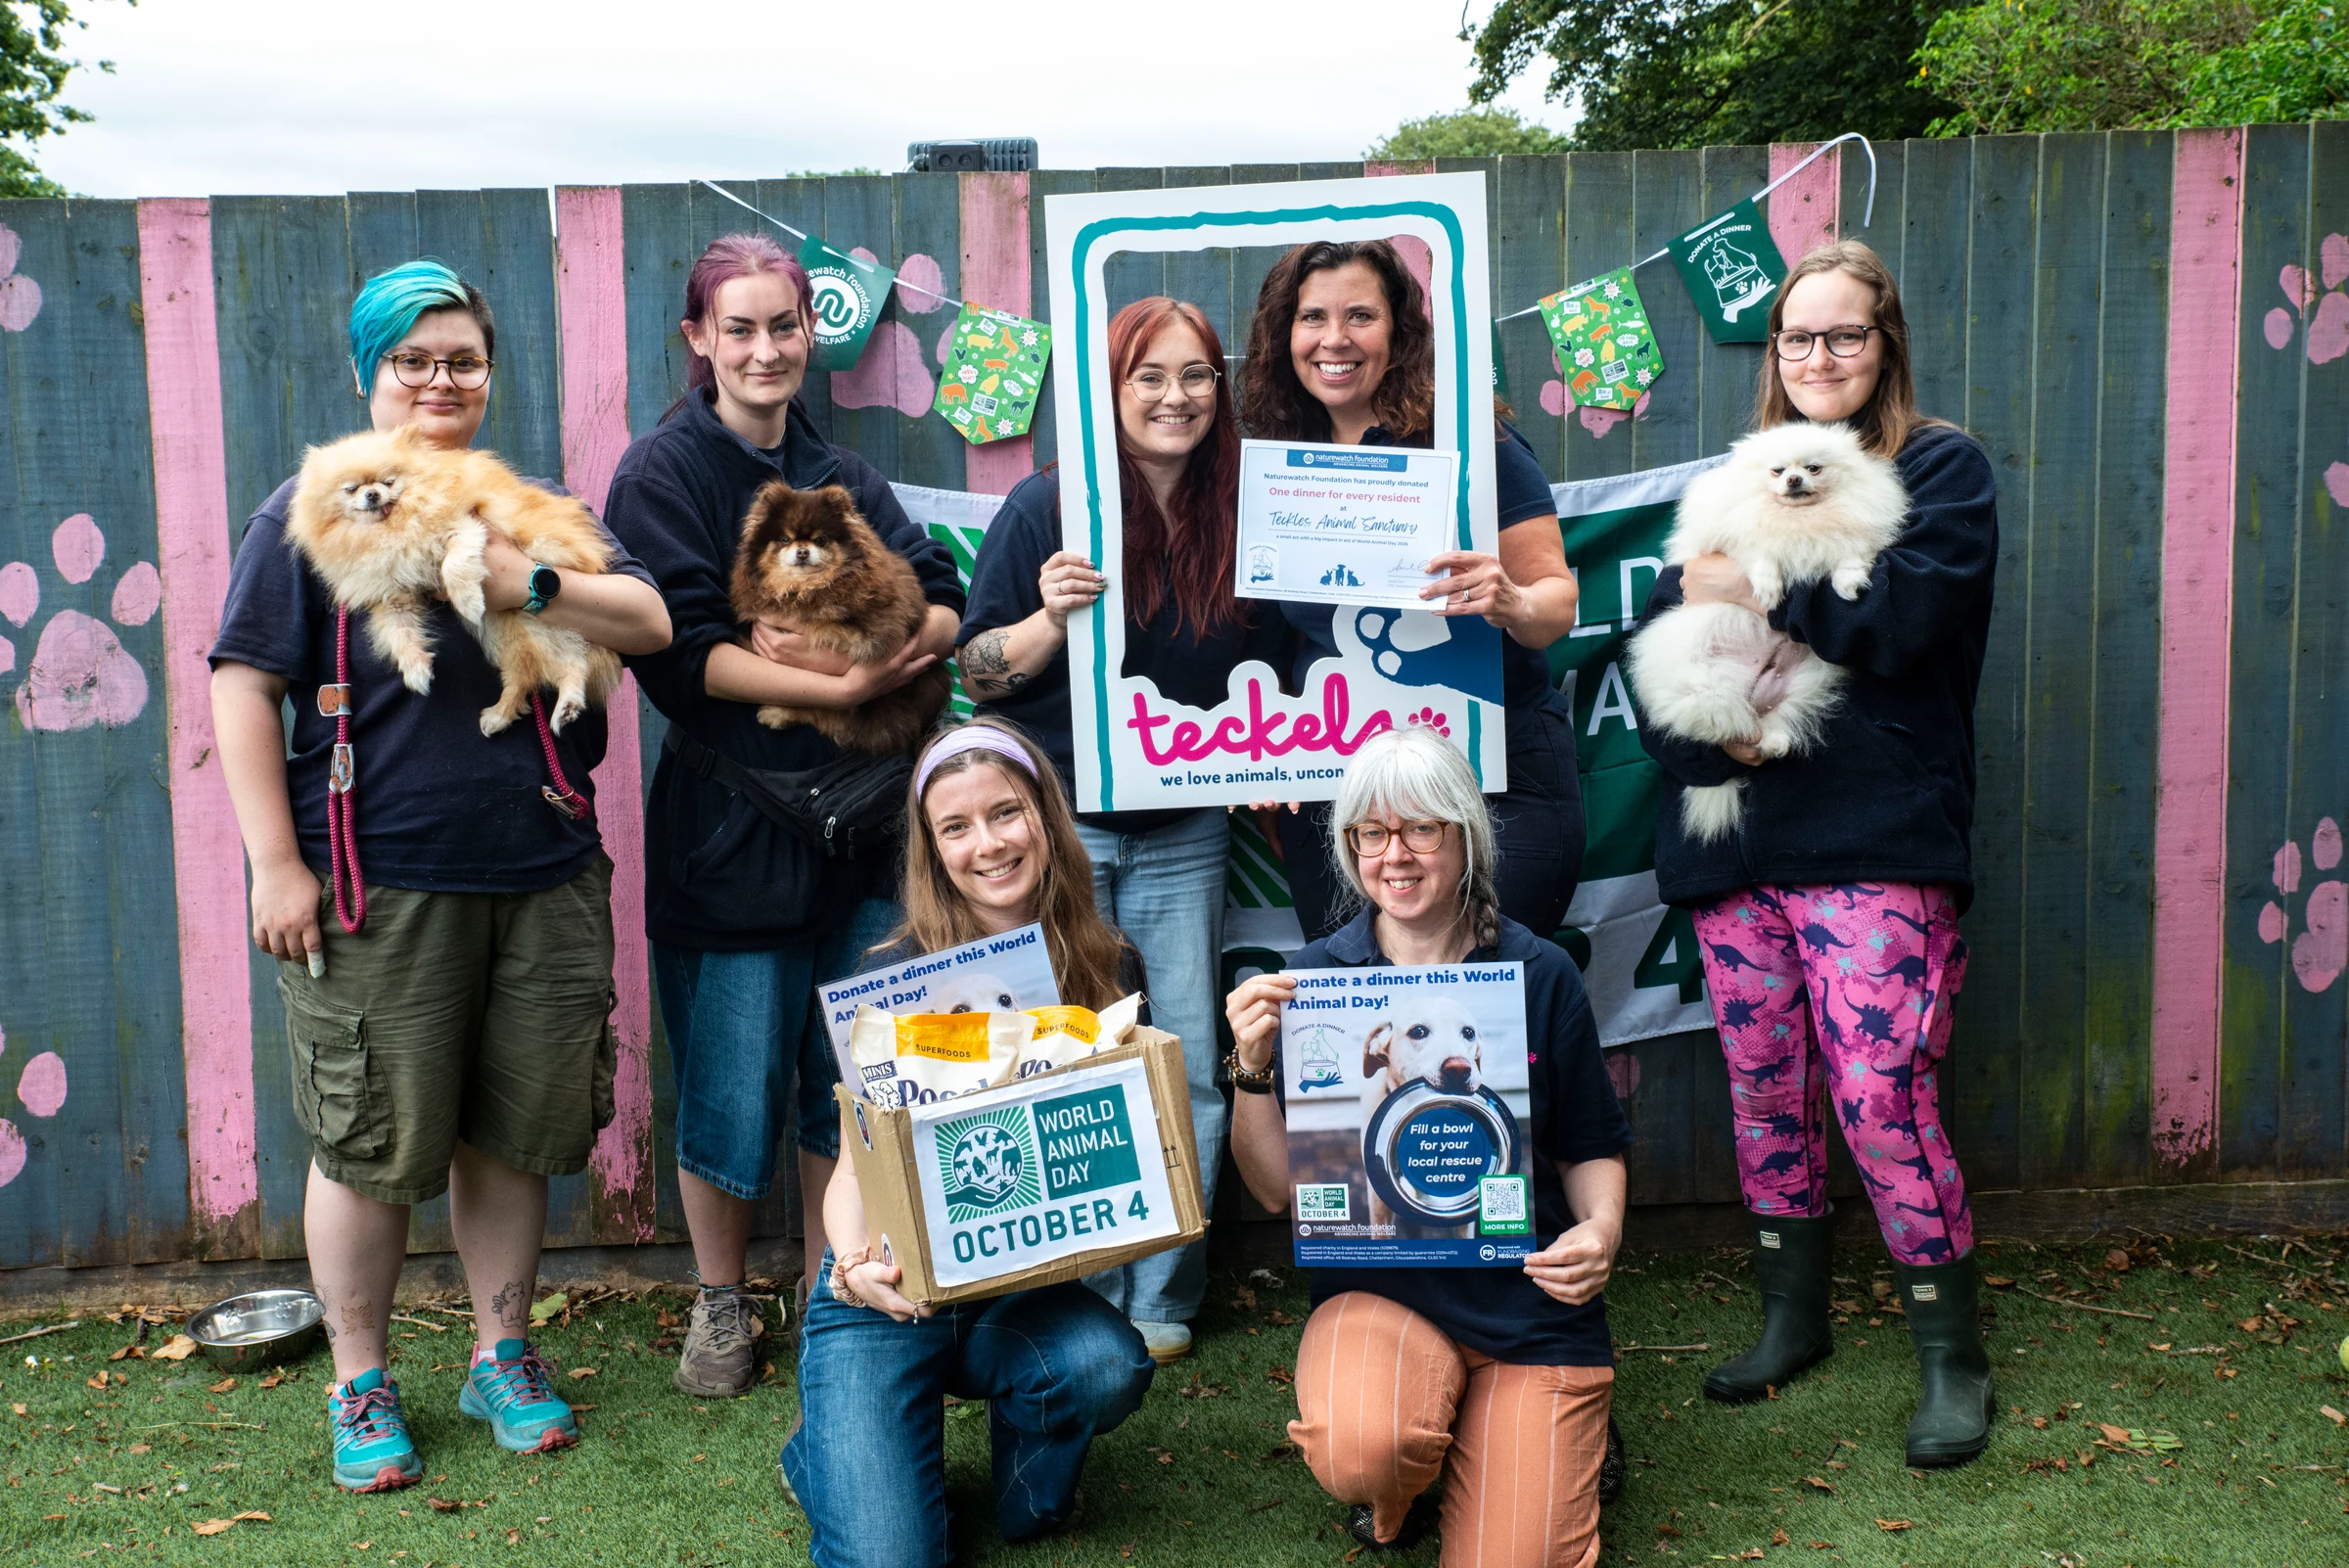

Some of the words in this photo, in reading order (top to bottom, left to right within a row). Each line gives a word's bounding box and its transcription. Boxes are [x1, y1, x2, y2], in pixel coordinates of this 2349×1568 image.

[1687, 235, 1713, 263] DONATE
[1720, 224, 1752, 235] DINNER
[847, 273, 871, 329] foundation
[1354, 455, 1389, 464] foundation
[1264, 473, 1311, 482] Naturewatch
[1312, 475, 1353, 484] Foundation
[1367, 479, 1397, 487] proudly
[1397, 480, 1429, 488] donated
[1268, 486, 1290, 496] One
[1292, 487, 1326, 498] dinner
[1328, 489, 1344, 499] for
[1346, 492, 1374, 502] every
[1377, 493, 1420, 503] resident
[1315, 514, 1359, 530] Animal
[1361, 516, 1418, 534] Sanctuary
[1160, 772, 1183, 787] we
[1187, 769, 1221, 786] love
[1224, 765, 1292, 784] animals,
[827, 979, 886, 1004] Donate
[889, 974, 898, 986] a
[901, 957, 952, 981] dinner
[955, 946, 987, 965] this
[988, 931, 1036, 955] World
[1352, 977, 1361, 987] a
[1366, 972, 1421, 986] dinner
[1426, 970, 1458, 984] this
[1463, 968, 1515, 982] World
[834, 999, 890, 1025] Anal
[893, 985, 928, 1005] Day!
[1287, 995, 1347, 1010] Animal
[1352, 994, 1389, 1010] Day!
[1036, 1023, 1090, 1038] SUPERFOODS
[1291, 1023, 1315, 1037] DONATE
[1322, 1023, 1346, 1035] DINNER
[915, 1043, 972, 1058] SUPERFOODS
[1038, 1098, 1115, 1134] WORLD
[1410, 1124, 1429, 1134] Fill
[1443, 1123, 1474, 1133] bowl
[1046, 1126, 1128, 1163] ANIMAL
[1419, 1139, 1438, 1151] for
[1440, 1140, 1469, 1152] your
[1407, 1156, 1438, 1167] local
[1441, 1157, 1483, 1166] rescue
[1052, 1161, 1089, 1189] DAY
[1425, 1173, 1466, 1182] centre
[952, 1197, 1118, 1264] OCTOBER
[1128, 1189, 1150, 1222] 4
[1357, 1222, 1397, 1231] foundation
